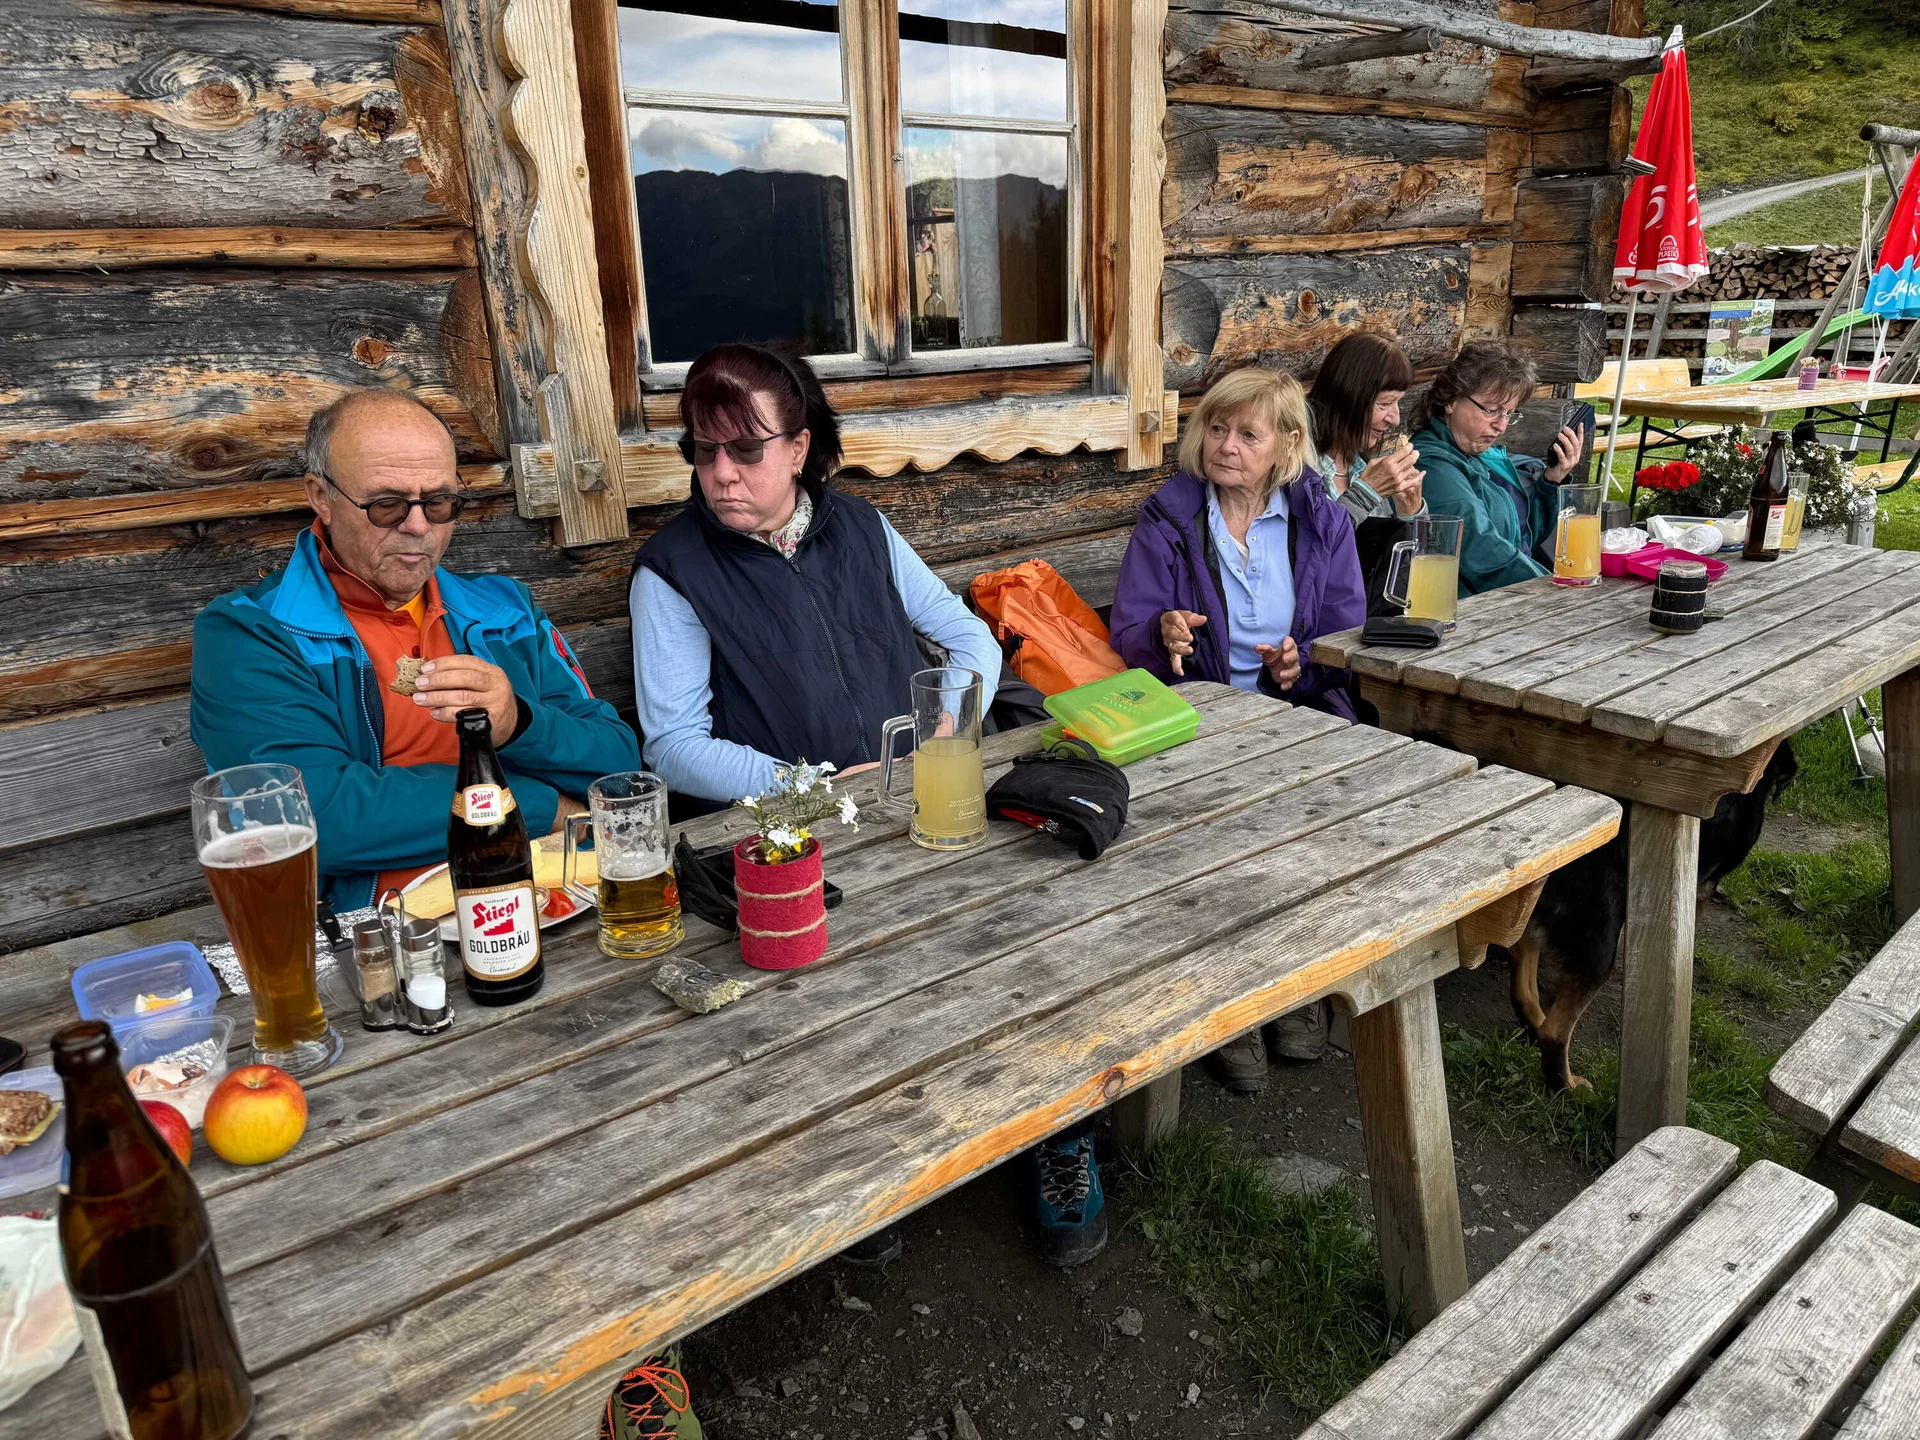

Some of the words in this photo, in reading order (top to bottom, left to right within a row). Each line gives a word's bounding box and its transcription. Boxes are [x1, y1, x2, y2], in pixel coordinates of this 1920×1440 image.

[470, 791, 494, 806] Stiegl
[471, 810, 498, 819] GOLDBRÄU
[472, 895, 520, 930] Stiegl
[469, 930, 530, 954] GOLDBRÄU
